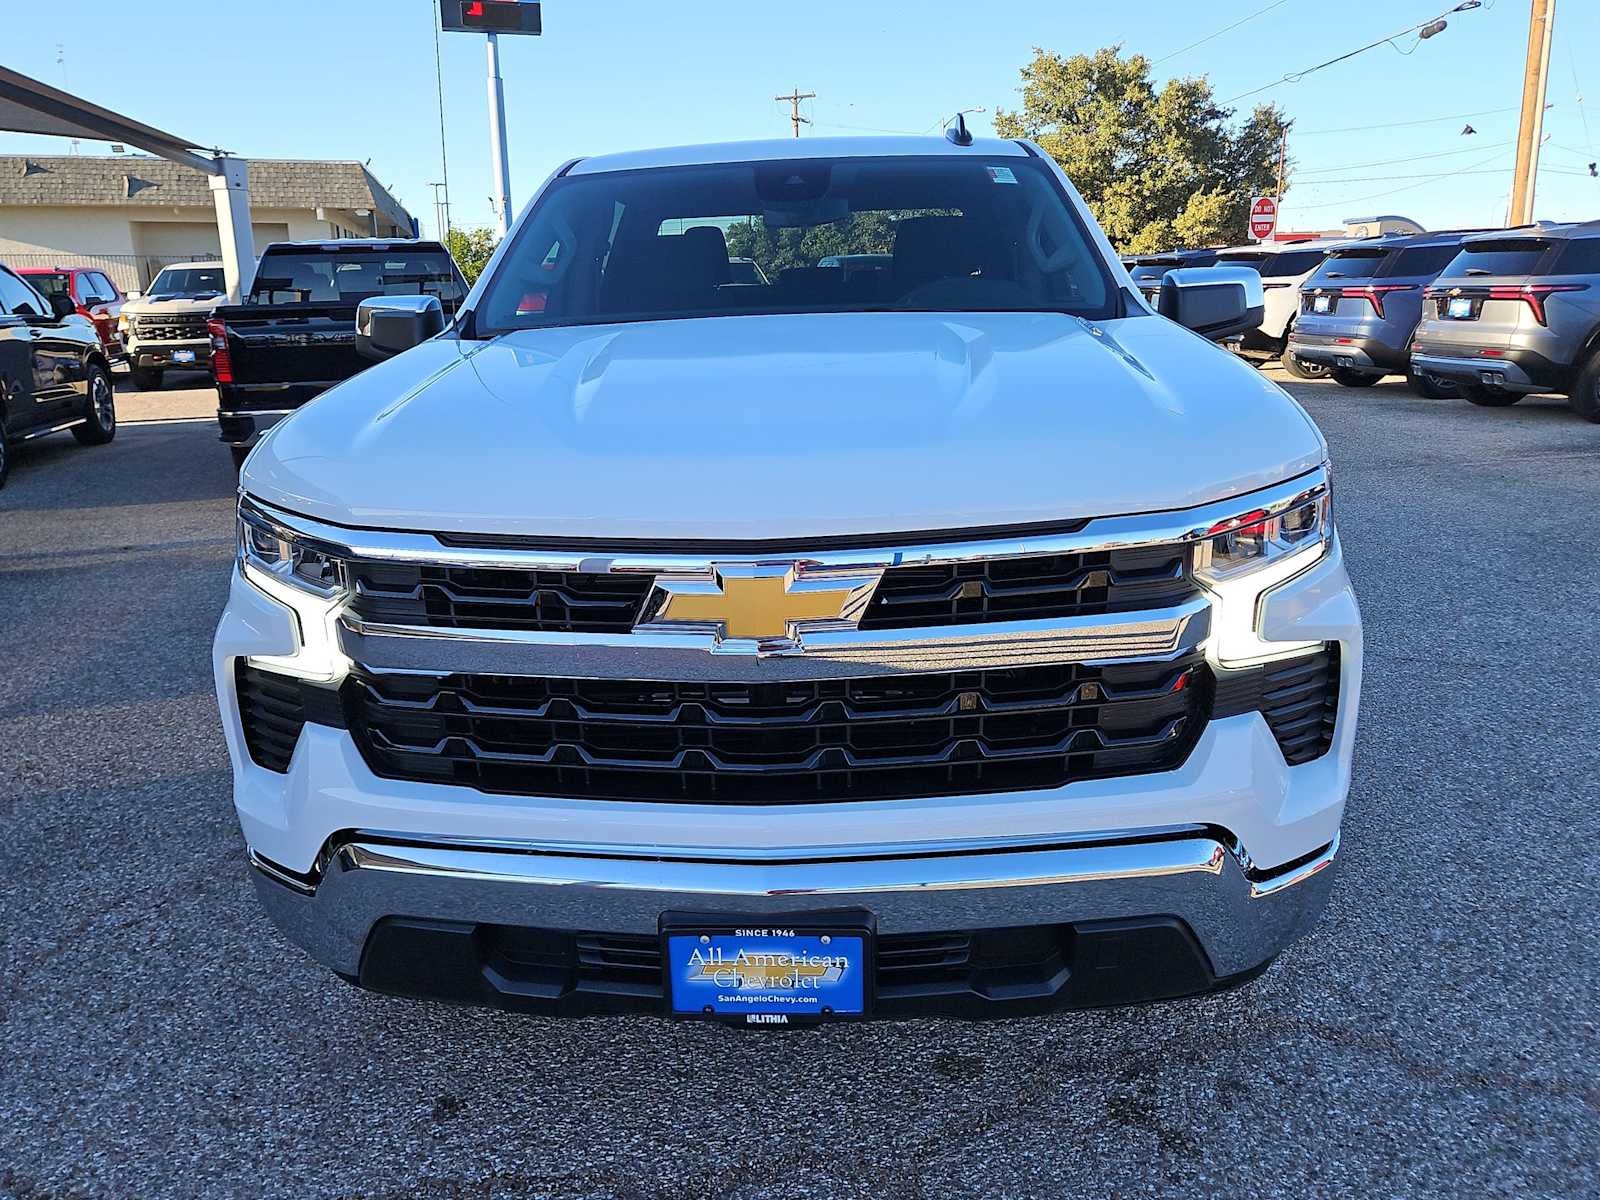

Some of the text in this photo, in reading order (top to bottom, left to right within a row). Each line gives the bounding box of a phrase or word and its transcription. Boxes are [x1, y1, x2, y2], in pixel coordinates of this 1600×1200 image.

[1254, 205, 1273, 213] DO NOT
[1254, 223, 1270, 232] ENTER
[735, 929, 795, 937] SINCE 1946
[687, 947, 849, 968] All American
[713, 968, 820, 990] Chevrolet
[717, 994, 818, 1004] SanAngeloChevy.com
[756, 1014, 789, 1024] LITHIA
